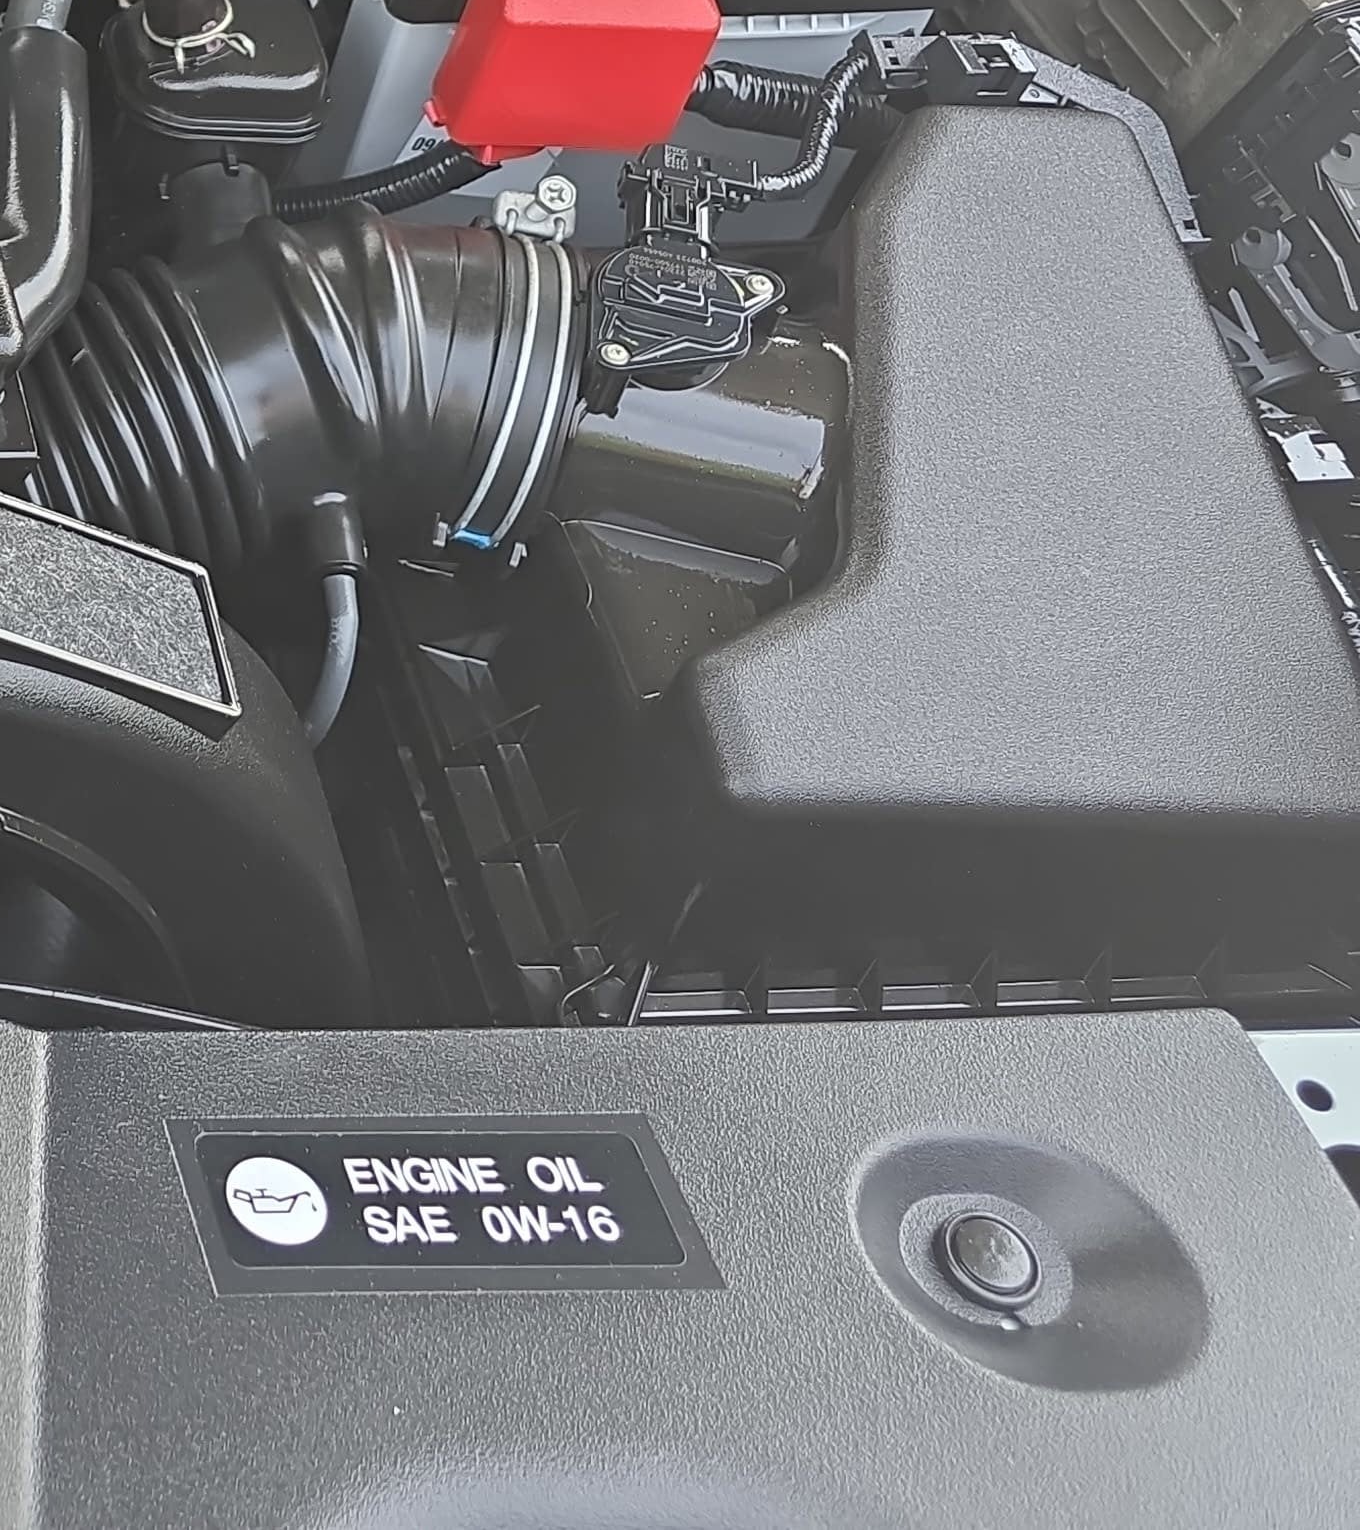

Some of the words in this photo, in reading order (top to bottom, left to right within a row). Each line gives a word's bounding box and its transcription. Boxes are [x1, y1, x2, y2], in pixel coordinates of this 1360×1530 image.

[341, 1155, 507, 1194] ENGINE
[525, 1154, 605, 1194] OIL
[362, 1204, 459, 1245] SAE
[480, 1204, 622, 1243] 0W-16
